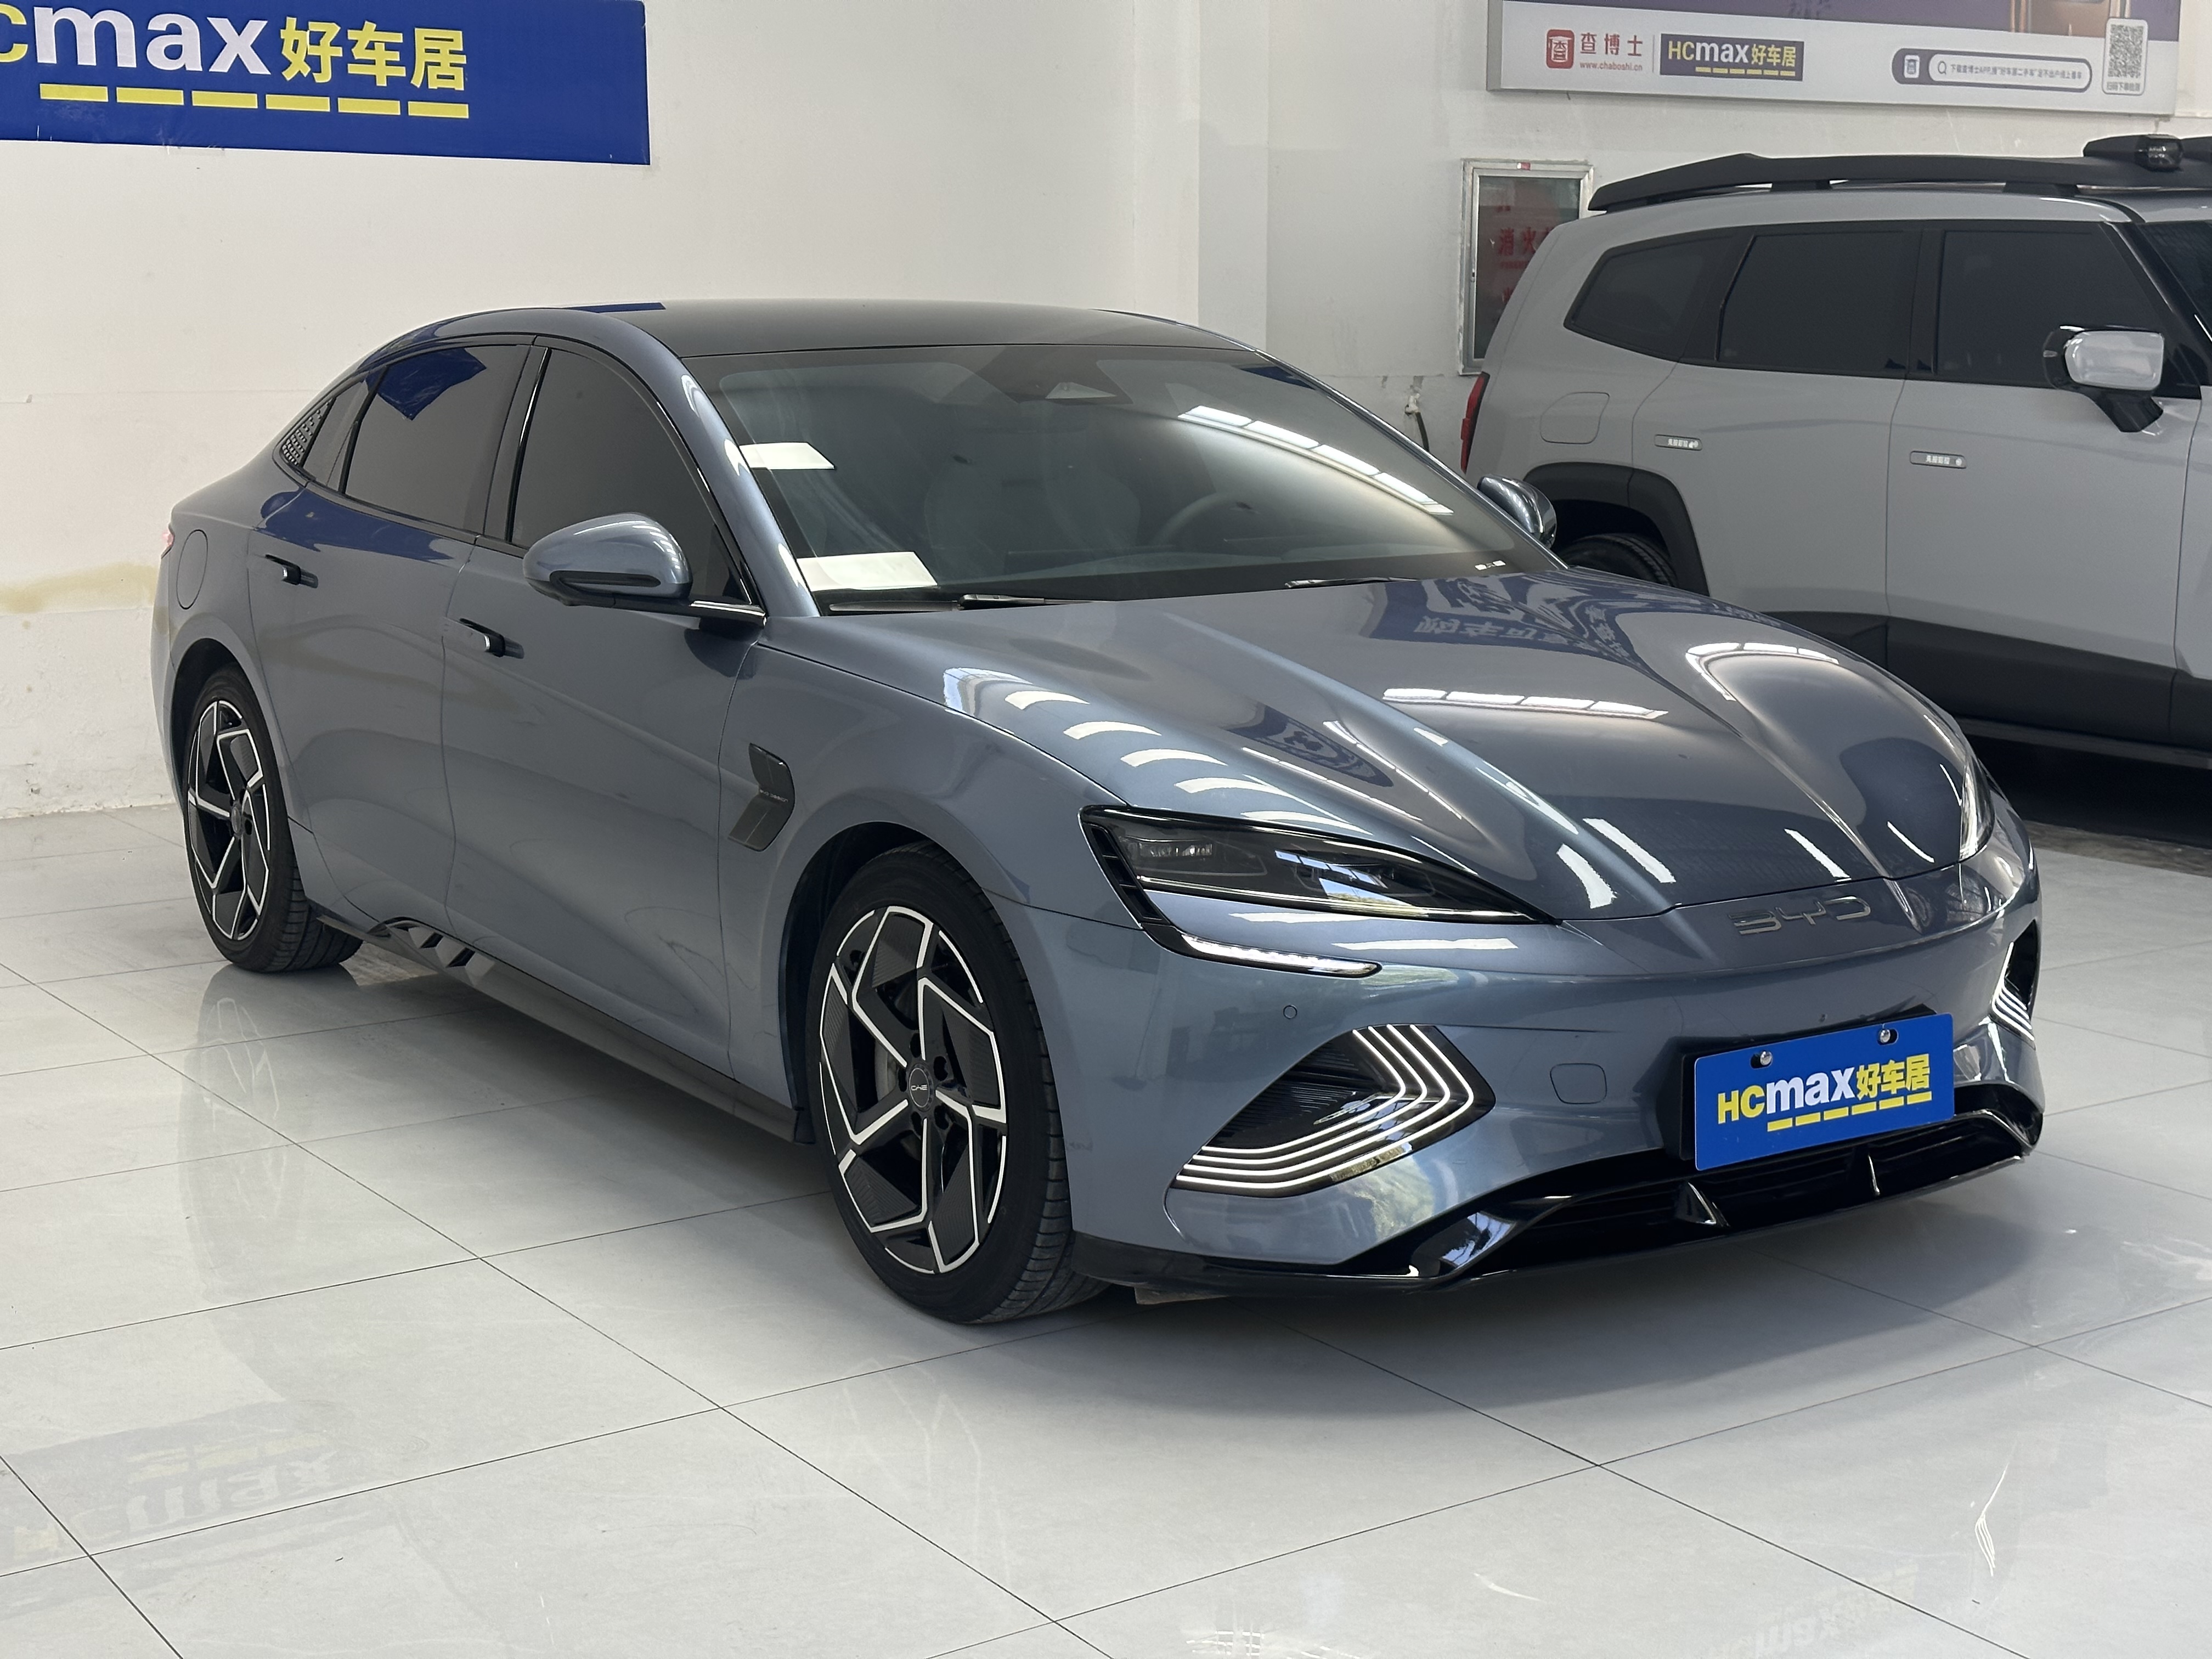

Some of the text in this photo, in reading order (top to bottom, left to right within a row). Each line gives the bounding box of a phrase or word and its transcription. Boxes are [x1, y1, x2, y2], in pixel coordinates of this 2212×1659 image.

[1580, 32, 1643, 57] 查博士
[1498, 227, 1554, 256] 消火
[1728, 895, 1871, 935] BYD
